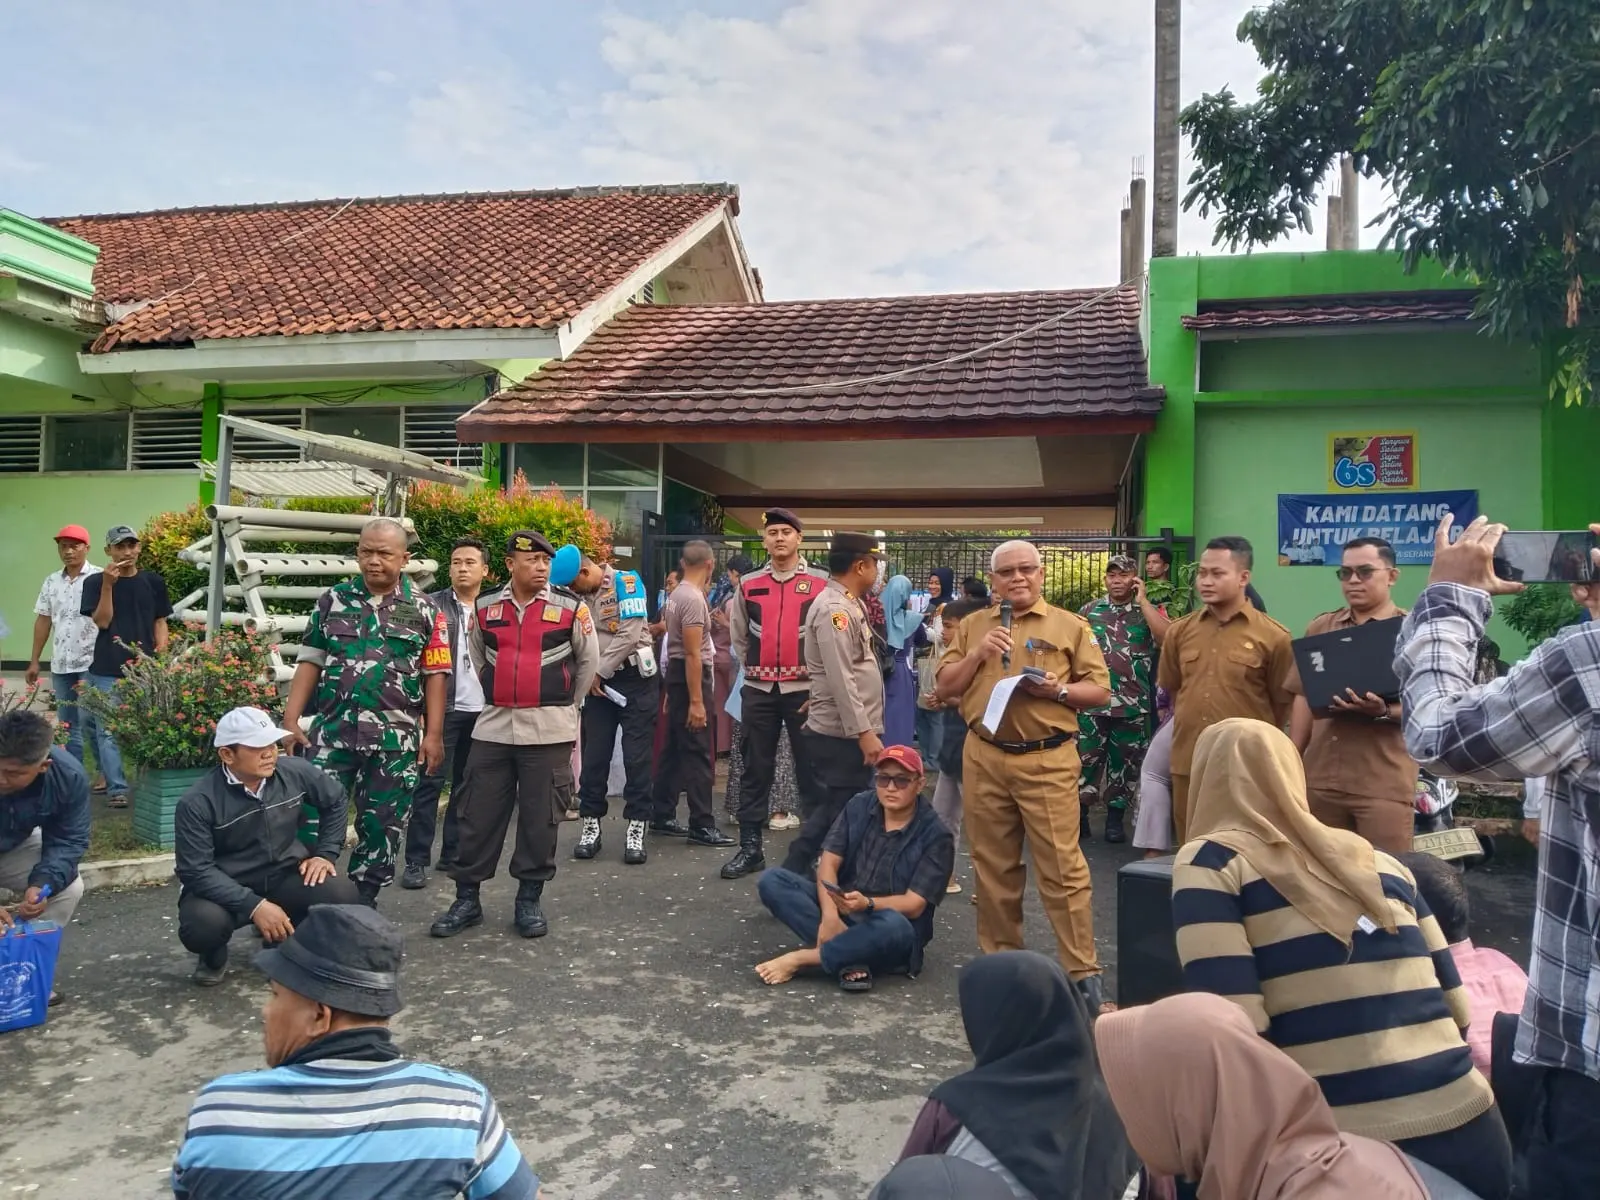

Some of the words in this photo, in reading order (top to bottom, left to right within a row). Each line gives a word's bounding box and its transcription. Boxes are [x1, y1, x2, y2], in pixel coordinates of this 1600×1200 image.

[1305, 505, 1358, 524] KAMI
[1361, 503, 1451, 522] DATANG
[1293, 527, 1361, 545] UNTUK
[1367, 525, 1464, 544] BELAJR
